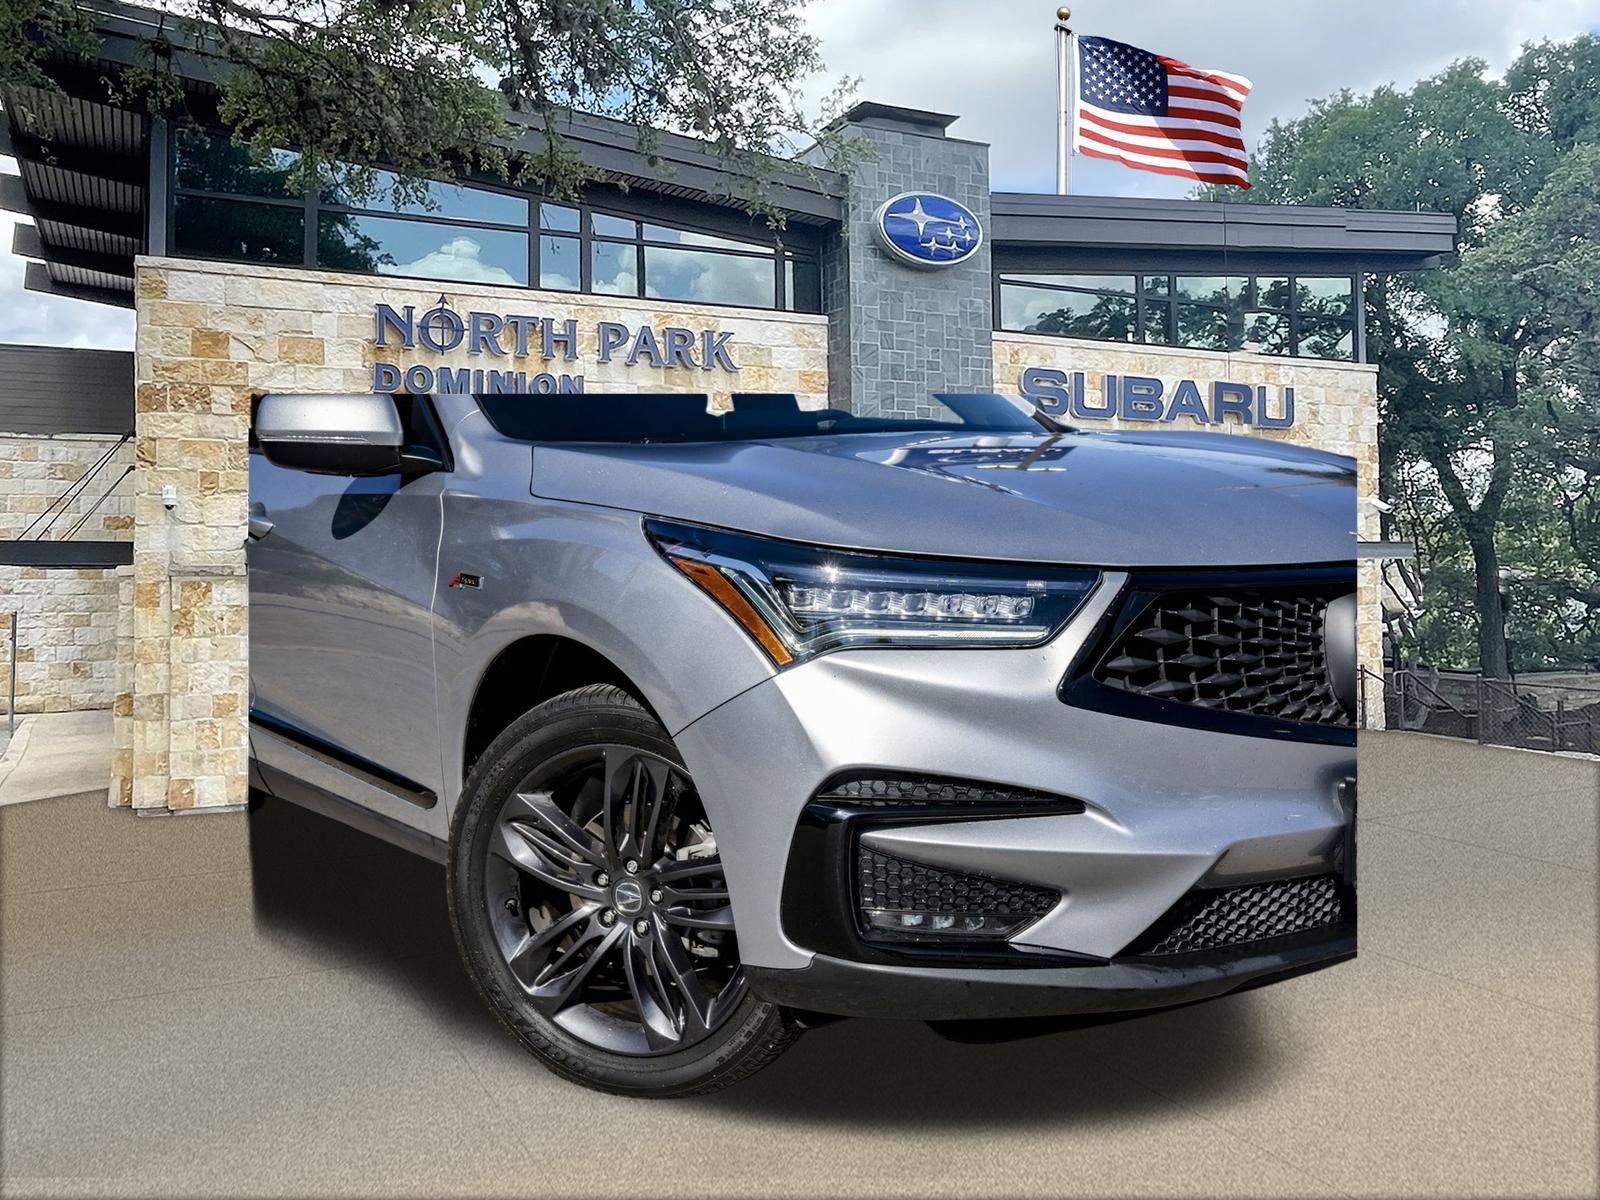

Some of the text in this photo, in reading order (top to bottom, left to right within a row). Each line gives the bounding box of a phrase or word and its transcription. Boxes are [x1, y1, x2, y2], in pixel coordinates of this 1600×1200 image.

[375, 301, 742, 373] NORTH PARK
[373, 362, 585, 394] DOMINION
[1019, 367, 1295, 429] SUBARU
